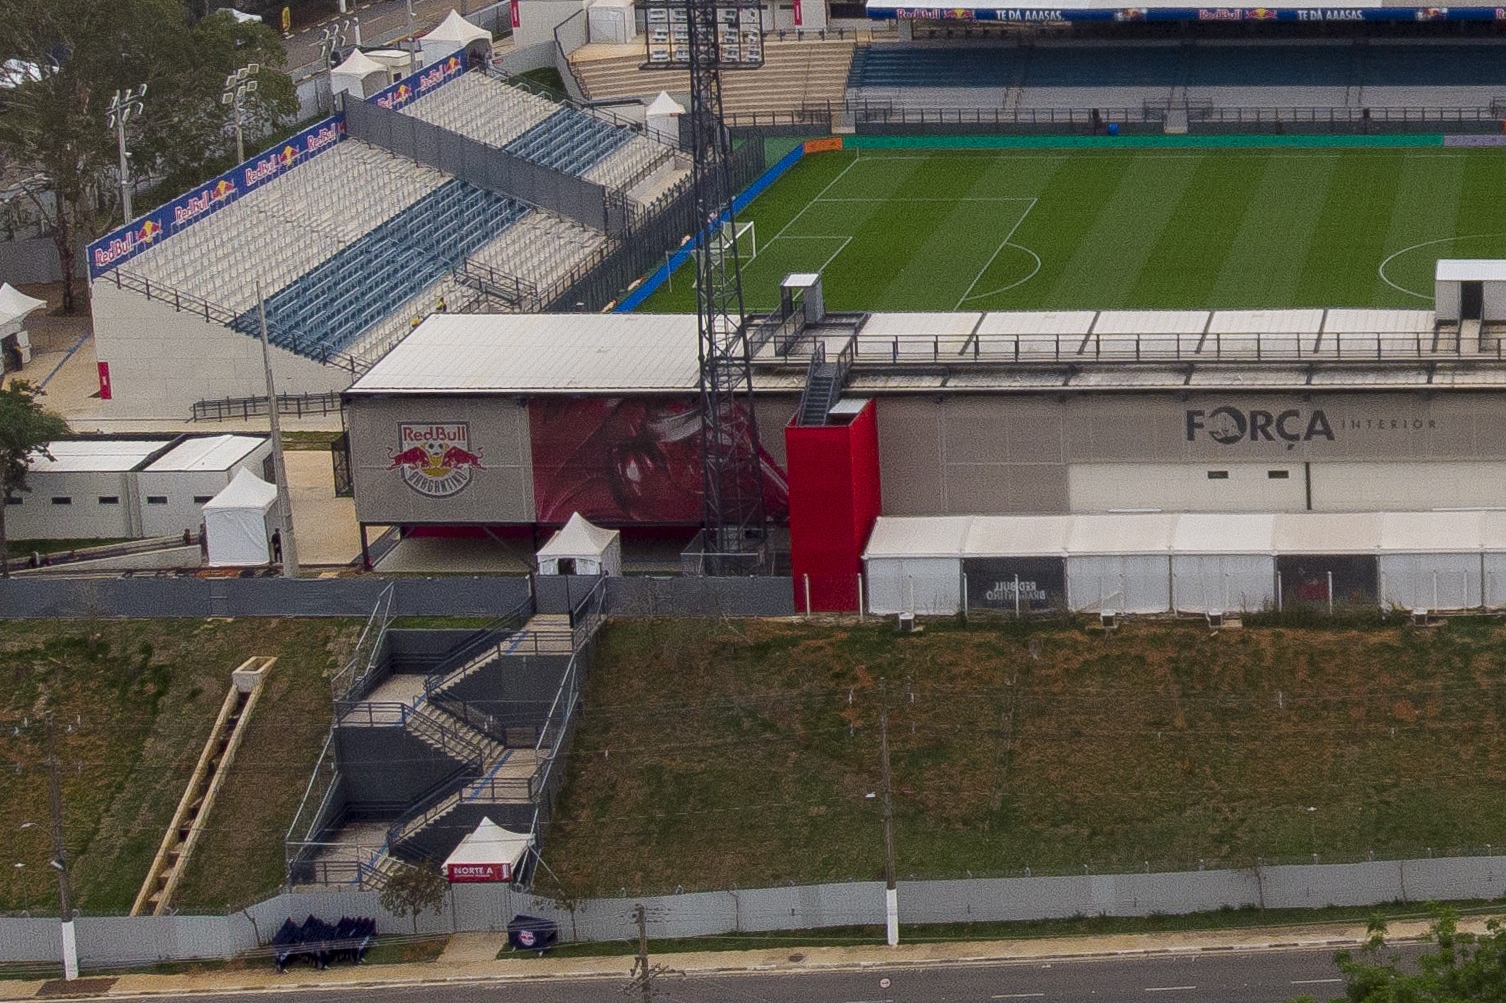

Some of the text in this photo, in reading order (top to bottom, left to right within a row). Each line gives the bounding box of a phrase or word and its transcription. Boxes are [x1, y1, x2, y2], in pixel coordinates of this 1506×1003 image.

[996, 10, 1007, 21] TE
[1297, 9, 1308, 21] TE
[1186, 406, 1437, 451] FORÇA INTERIOR
[454, 867, 484, 875] NORTE
